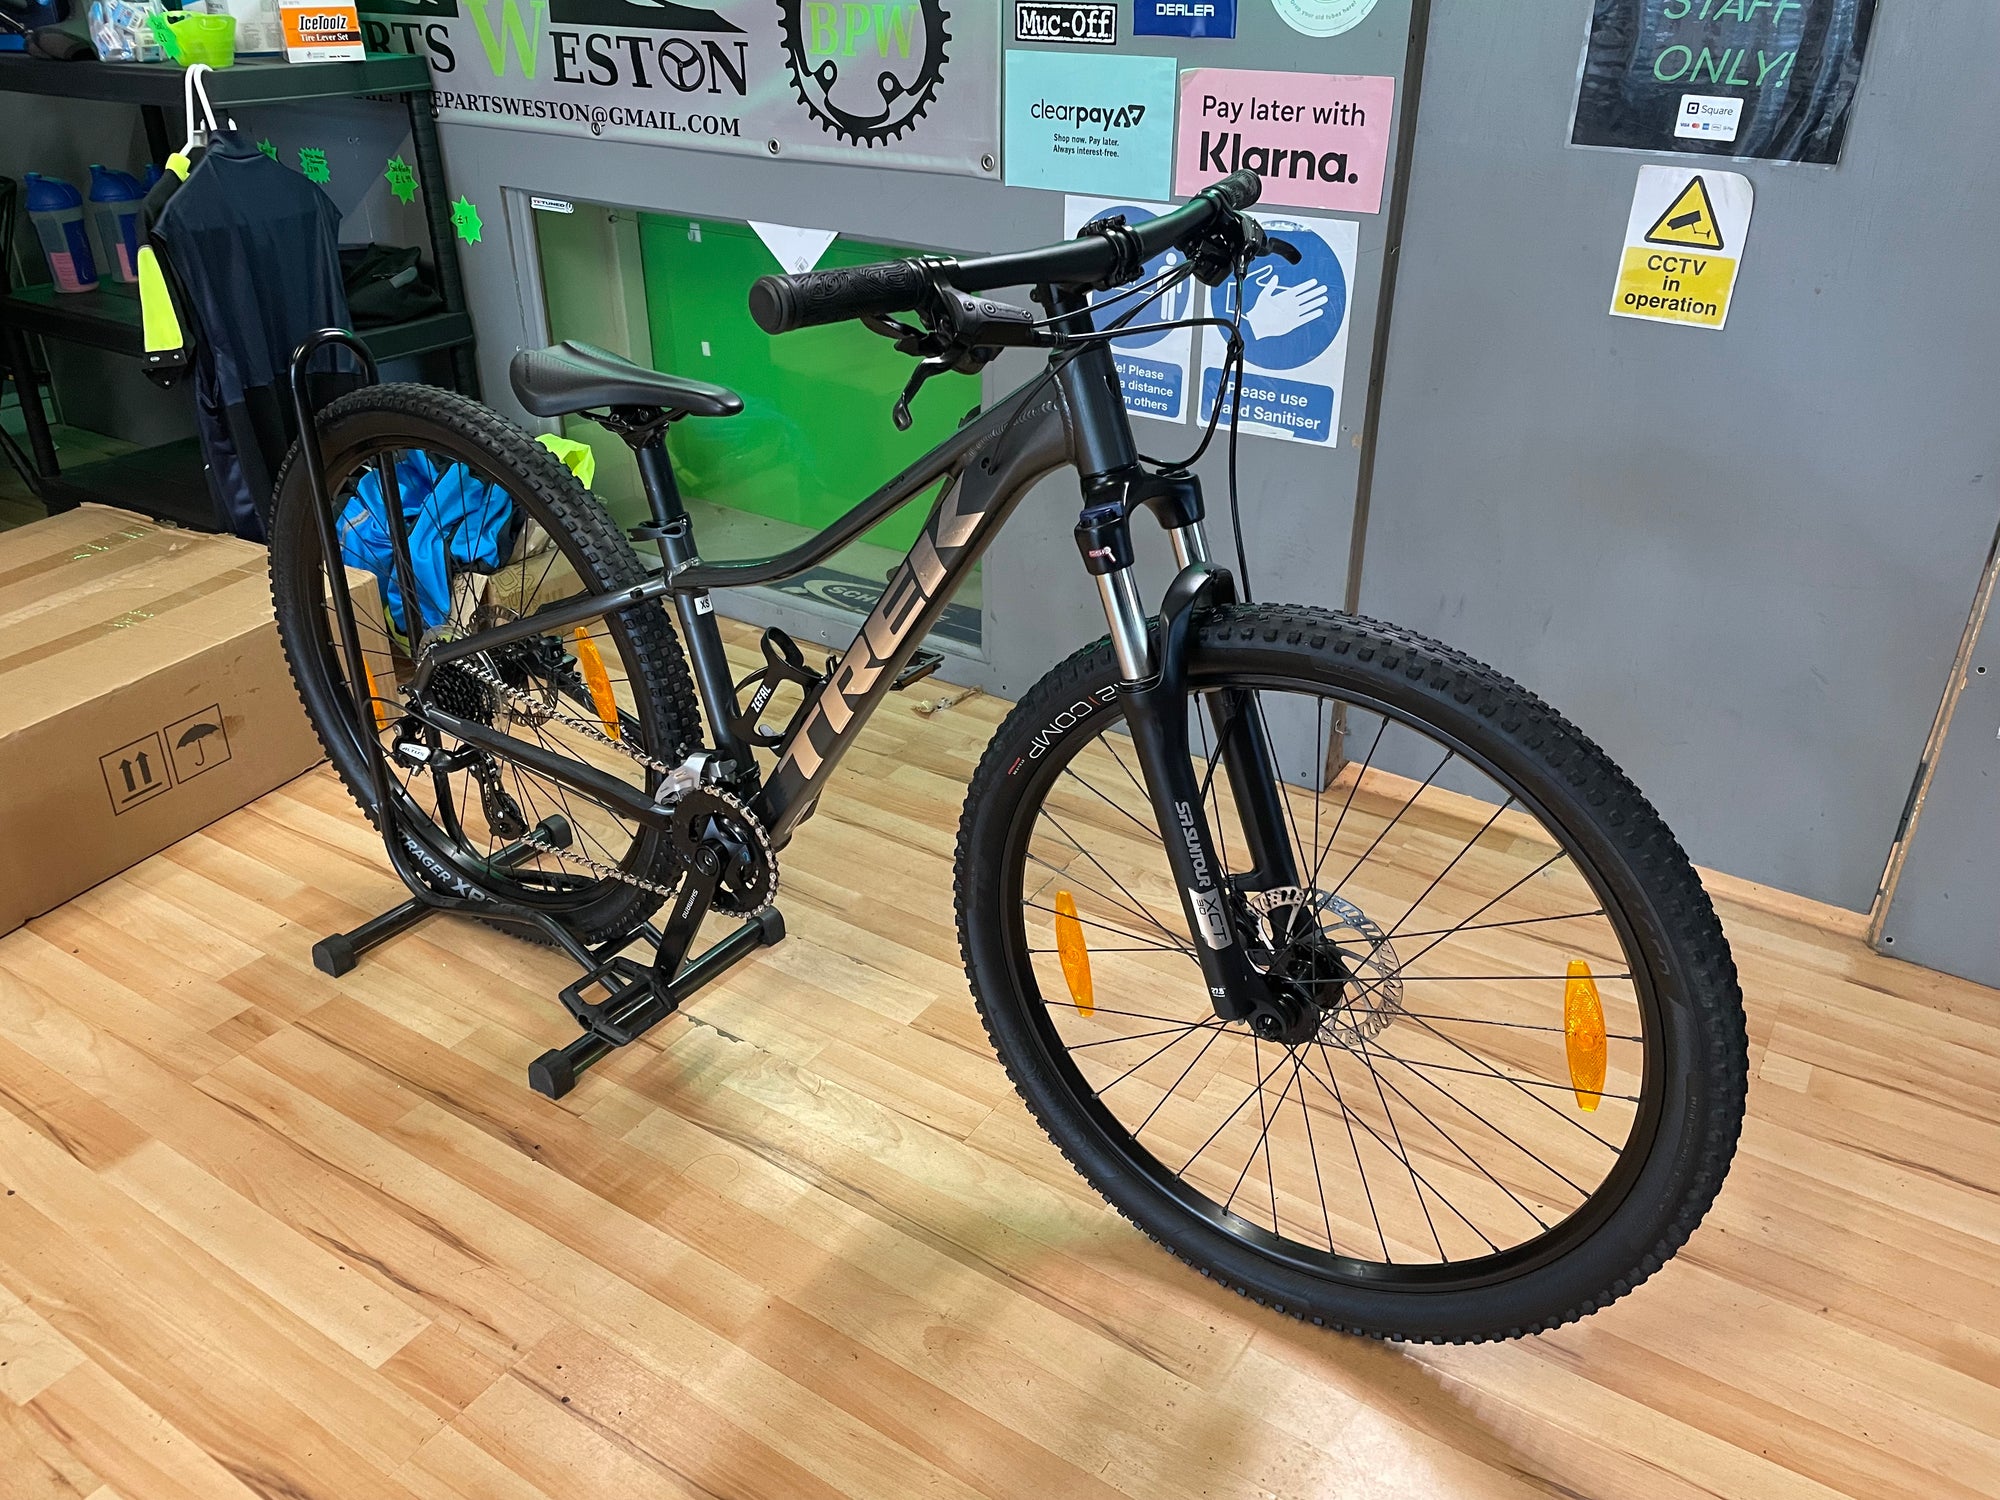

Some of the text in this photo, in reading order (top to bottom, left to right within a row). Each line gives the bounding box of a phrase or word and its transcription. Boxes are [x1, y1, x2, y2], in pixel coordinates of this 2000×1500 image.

[1155, 3, 1215, 17] DEALER
[299, 15, 347, 31] IceToolz
[806, 3, 919, 59] BPW
[1021, 10, 1112, 38] Muc-Off
[301, 32, 349, 42] Tire Lever Set
[1653, 45, 1797, 88] ONLY!
[433, 90, 741, 138] EPARTSWESTON@GMAIL.COM
[1030, 98, 1115, 132] clearpay
[1202, 95, 1366, 127] Pay later with
[1701, 104, 1734, 116] Square
[1053, 133, 1120, 146] Shop now. Pay later.
[1053, 144, 1120, 158] Always interest-free.
[1199, 131, 1359, 185] Klarna.
[1647, 255, 1707, 276] CCTV
[1662, 275, 1680, 292] in
[1624, 292, 1717, 316] operation
[1128, 364, 1164, 380] Please
[1128, 381, 1173, 397] distance
[1226, 381, 1308, 407] Pease use
[1134, 397, 1168, 411] others
[1253, 406, 1321, 430] Sanitiser
[700, 598, 711, 610] XS
[777, 469, 986, 780] TREK
[1028, 701, 1093, 759] COMP
[400, 831, 452, 883] TRAGER
[1182, 826, 1212, 888] SUNTOUR
[681, 889, 699, 919] SHIMANO
[1203, 898, 1228, 941] XCT
